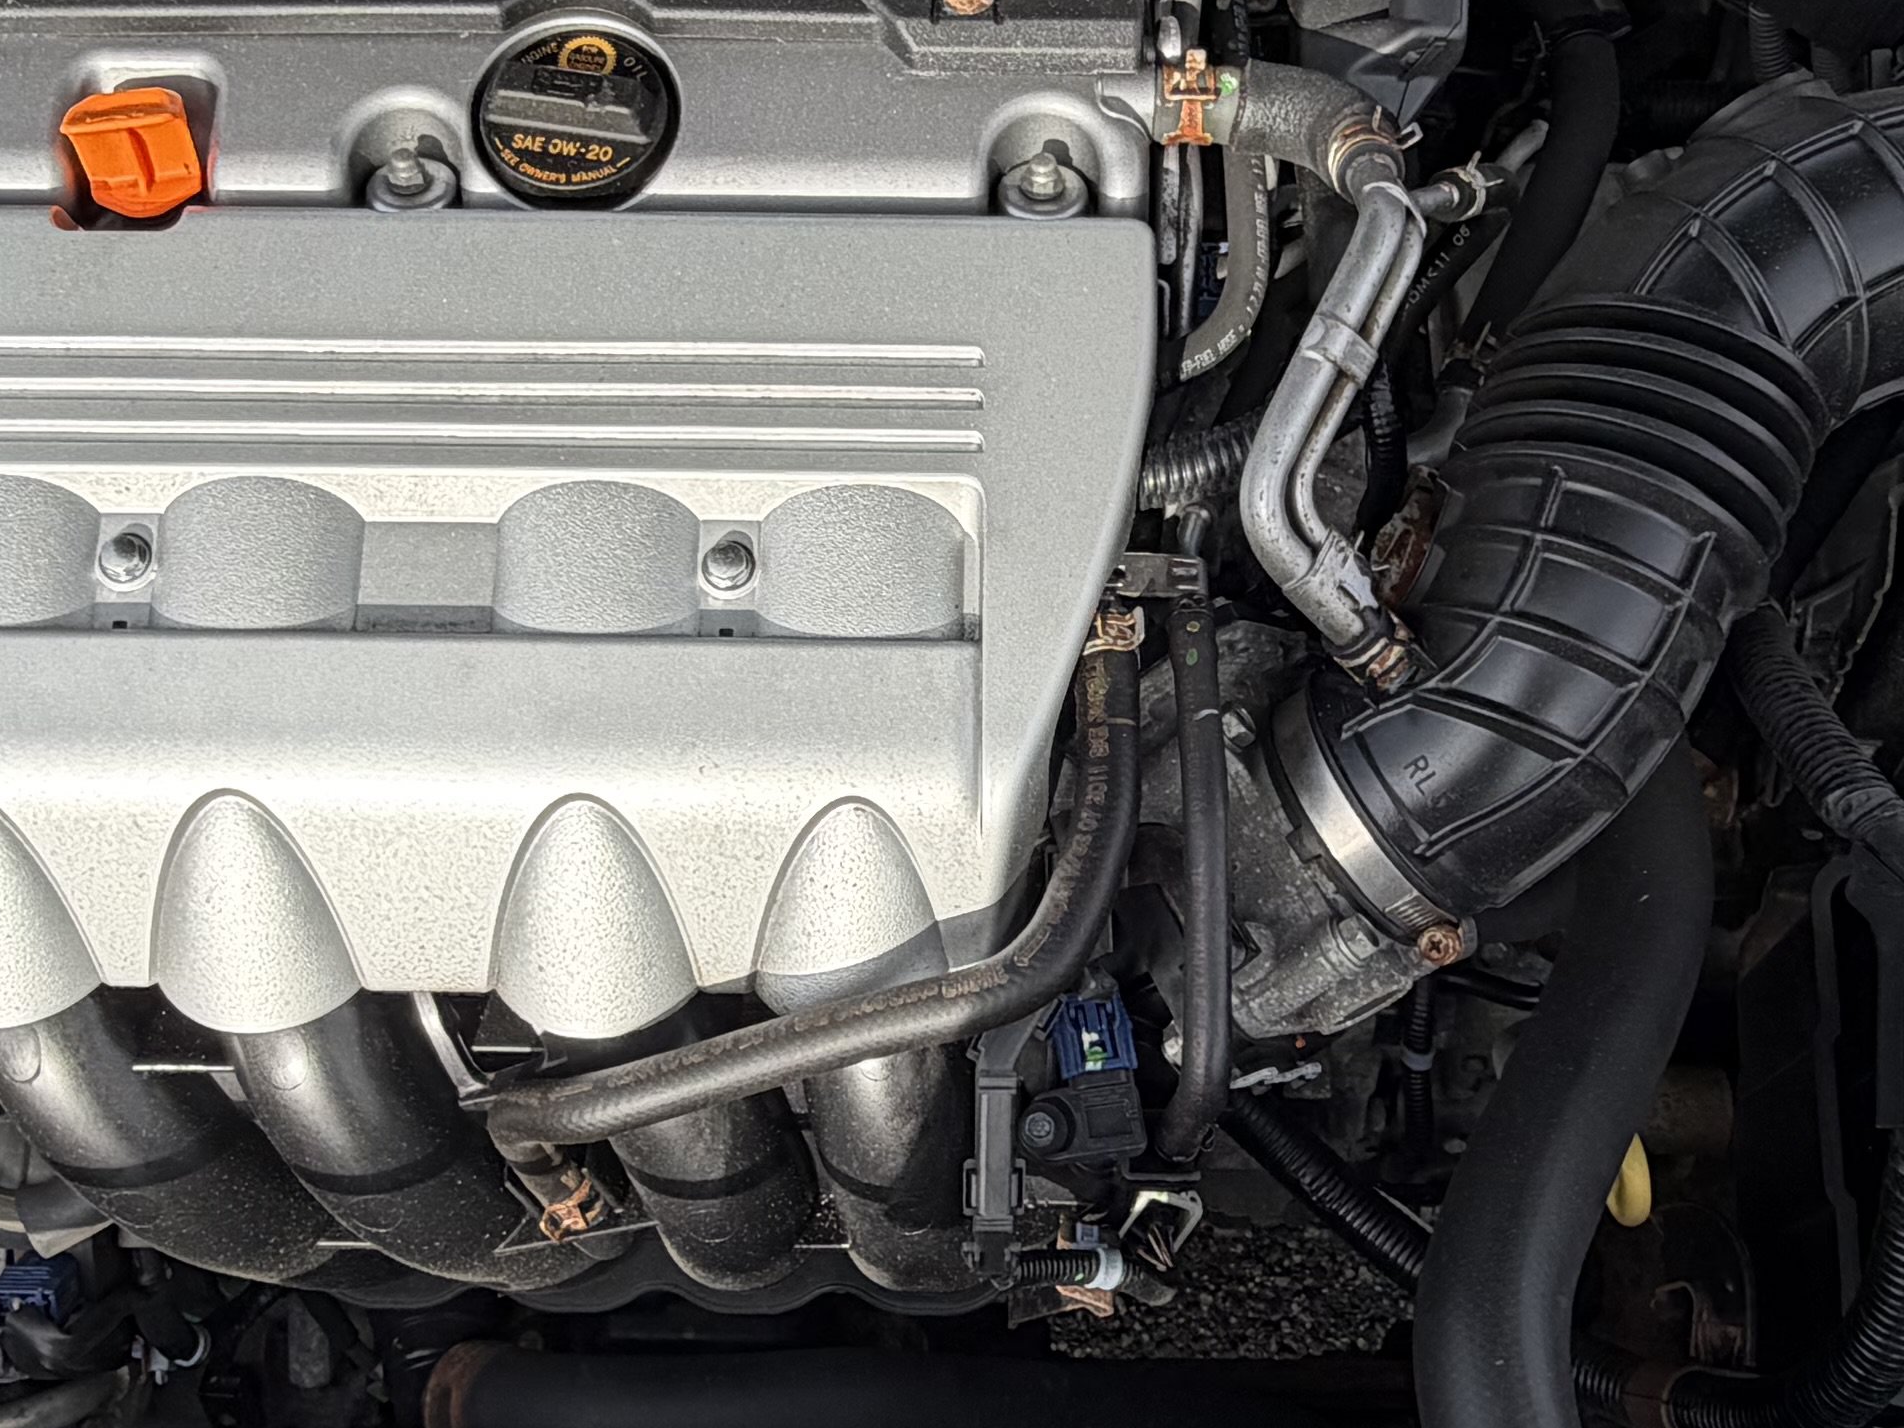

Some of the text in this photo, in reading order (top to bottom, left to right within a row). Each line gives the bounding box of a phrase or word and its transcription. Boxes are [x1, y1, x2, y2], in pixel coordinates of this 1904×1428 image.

[623, 56, 648, 79] OIL
[511, 133, 546, 152] SAE
[500, 149, 618, 184] SEE OWNER'S MANUAL
